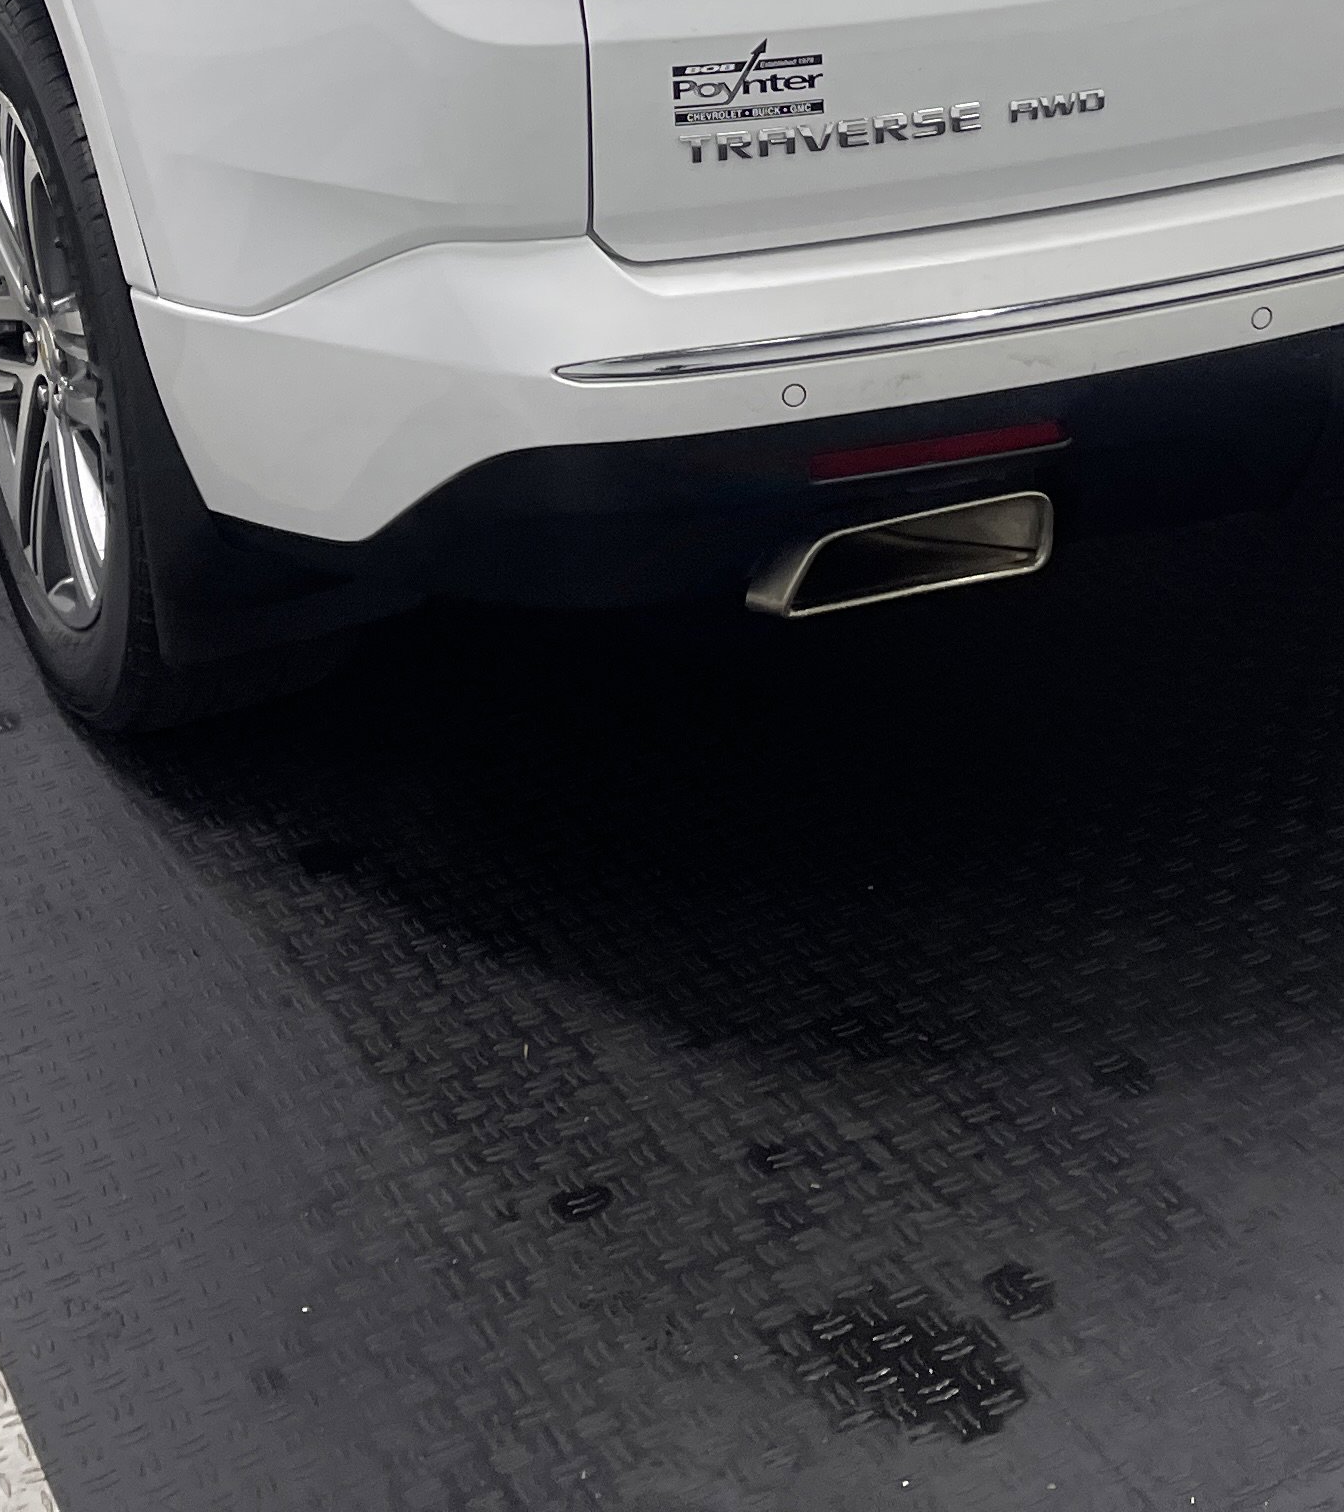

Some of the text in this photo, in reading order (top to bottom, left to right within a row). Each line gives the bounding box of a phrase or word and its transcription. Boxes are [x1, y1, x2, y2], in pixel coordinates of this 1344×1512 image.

[684, 63, 736, 75] BOB
[672, 73, 824, 105] Poynter
[678, 88, 1105, 164] TRAVERSE AWD
[686, 103, 812, 123] CHEVROLET BUICK GMC
